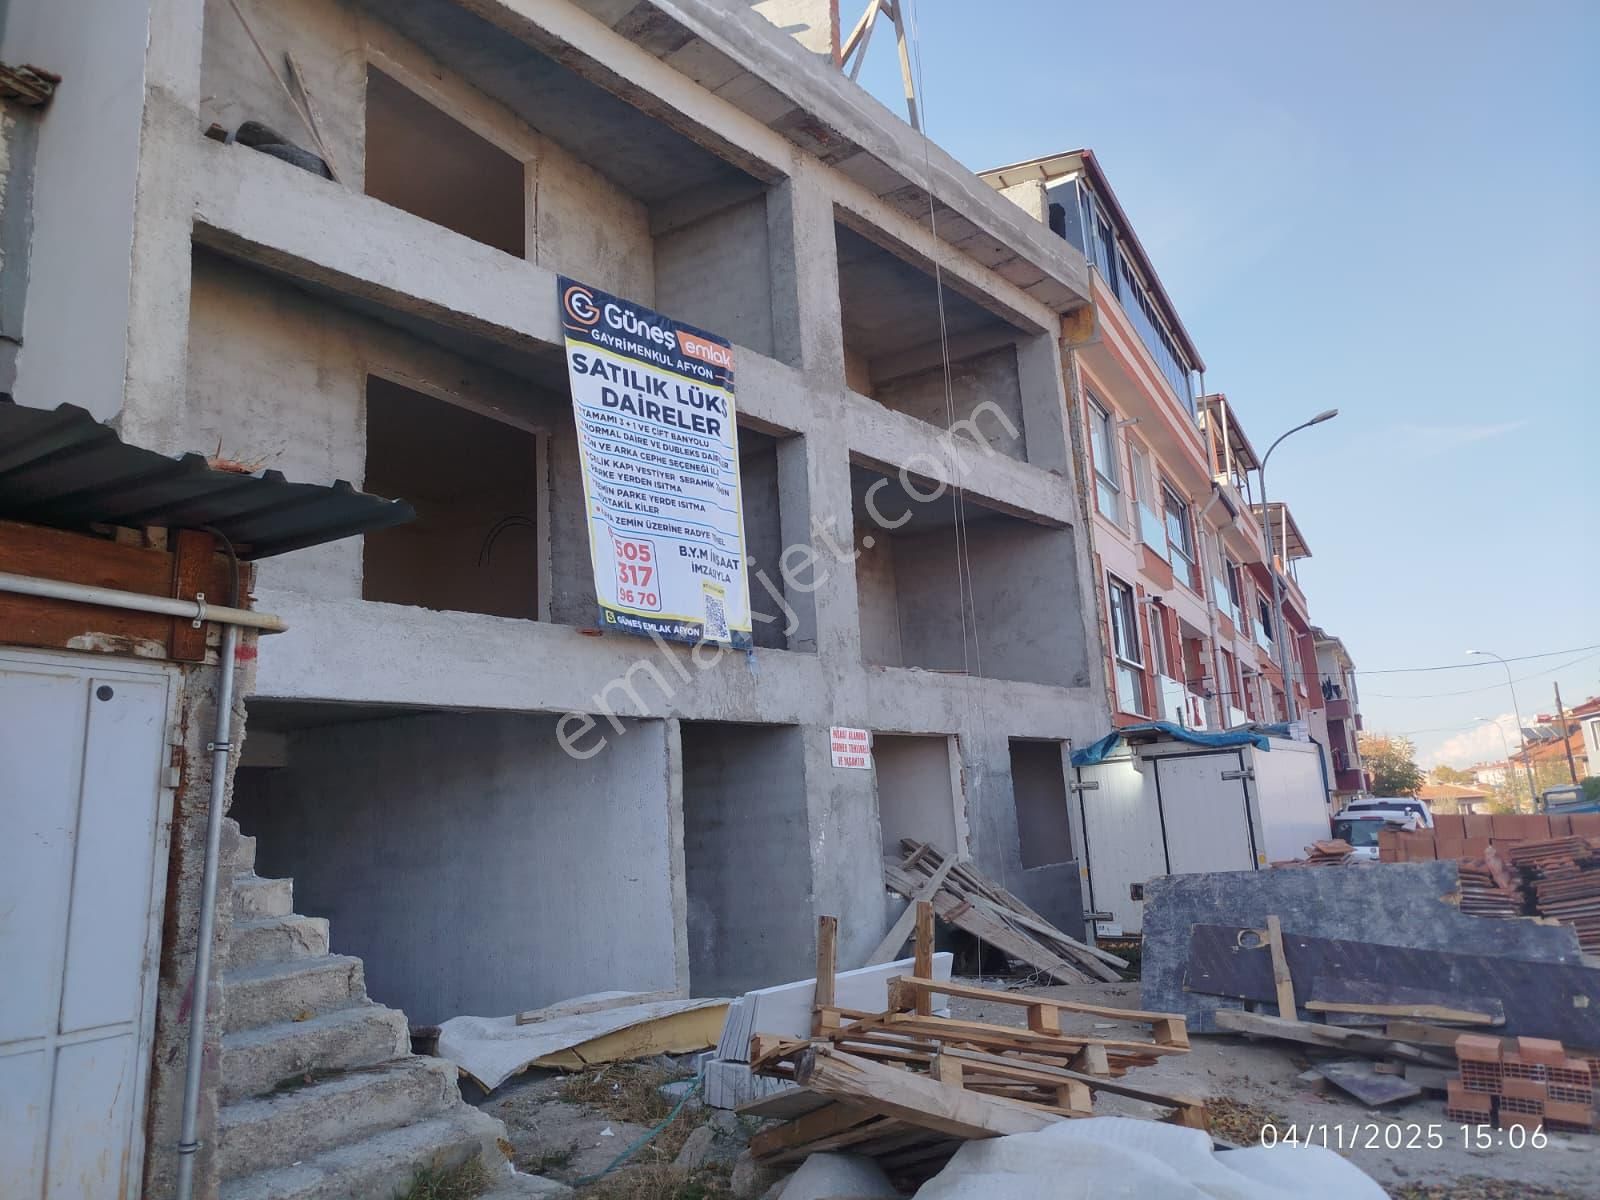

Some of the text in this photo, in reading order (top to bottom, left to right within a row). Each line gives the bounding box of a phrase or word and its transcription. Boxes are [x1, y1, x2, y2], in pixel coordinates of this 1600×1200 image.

[604, 303, 676, 350] Güneş
[591, 329, 714, 380] GAYRİMENKUL AFYON
[684, 341, 731, 367] emlak
[572, 353, 728, 418] SATILIK LÜKS
[602, 386, 721, 437] DAİRELER
[638, 424, 650, 433] VE
[671, 433, 710, 448] BANYOLU
[650, 440, 661, 449] VE
[599, 442, 611, 451] VE
[614, 446, 638, 458] ARKA
[640, 452, 667, 465] CEPHE
[613, 460, 634, 471] KAPI
[636, 466, 675, 480] VESTİYER
[680, 475, 714, 489] SERAMİK
[618, 473, 652, 487] YERDEN
[617, 489, 646, 500] PARKE
[649, 494, 677, 507] YERDE
[616, 516, 643, 528] ZEMİN
[646, 519, 682, 534] ÜZERİNE
[684, 527, 710, 539] RADYE
[615, 539, 651, 562] 505
[618, 561, 653, 587] 317
[619, 588, 657, 607] 96 70
[642, 622, 671, 634] EMLAK
